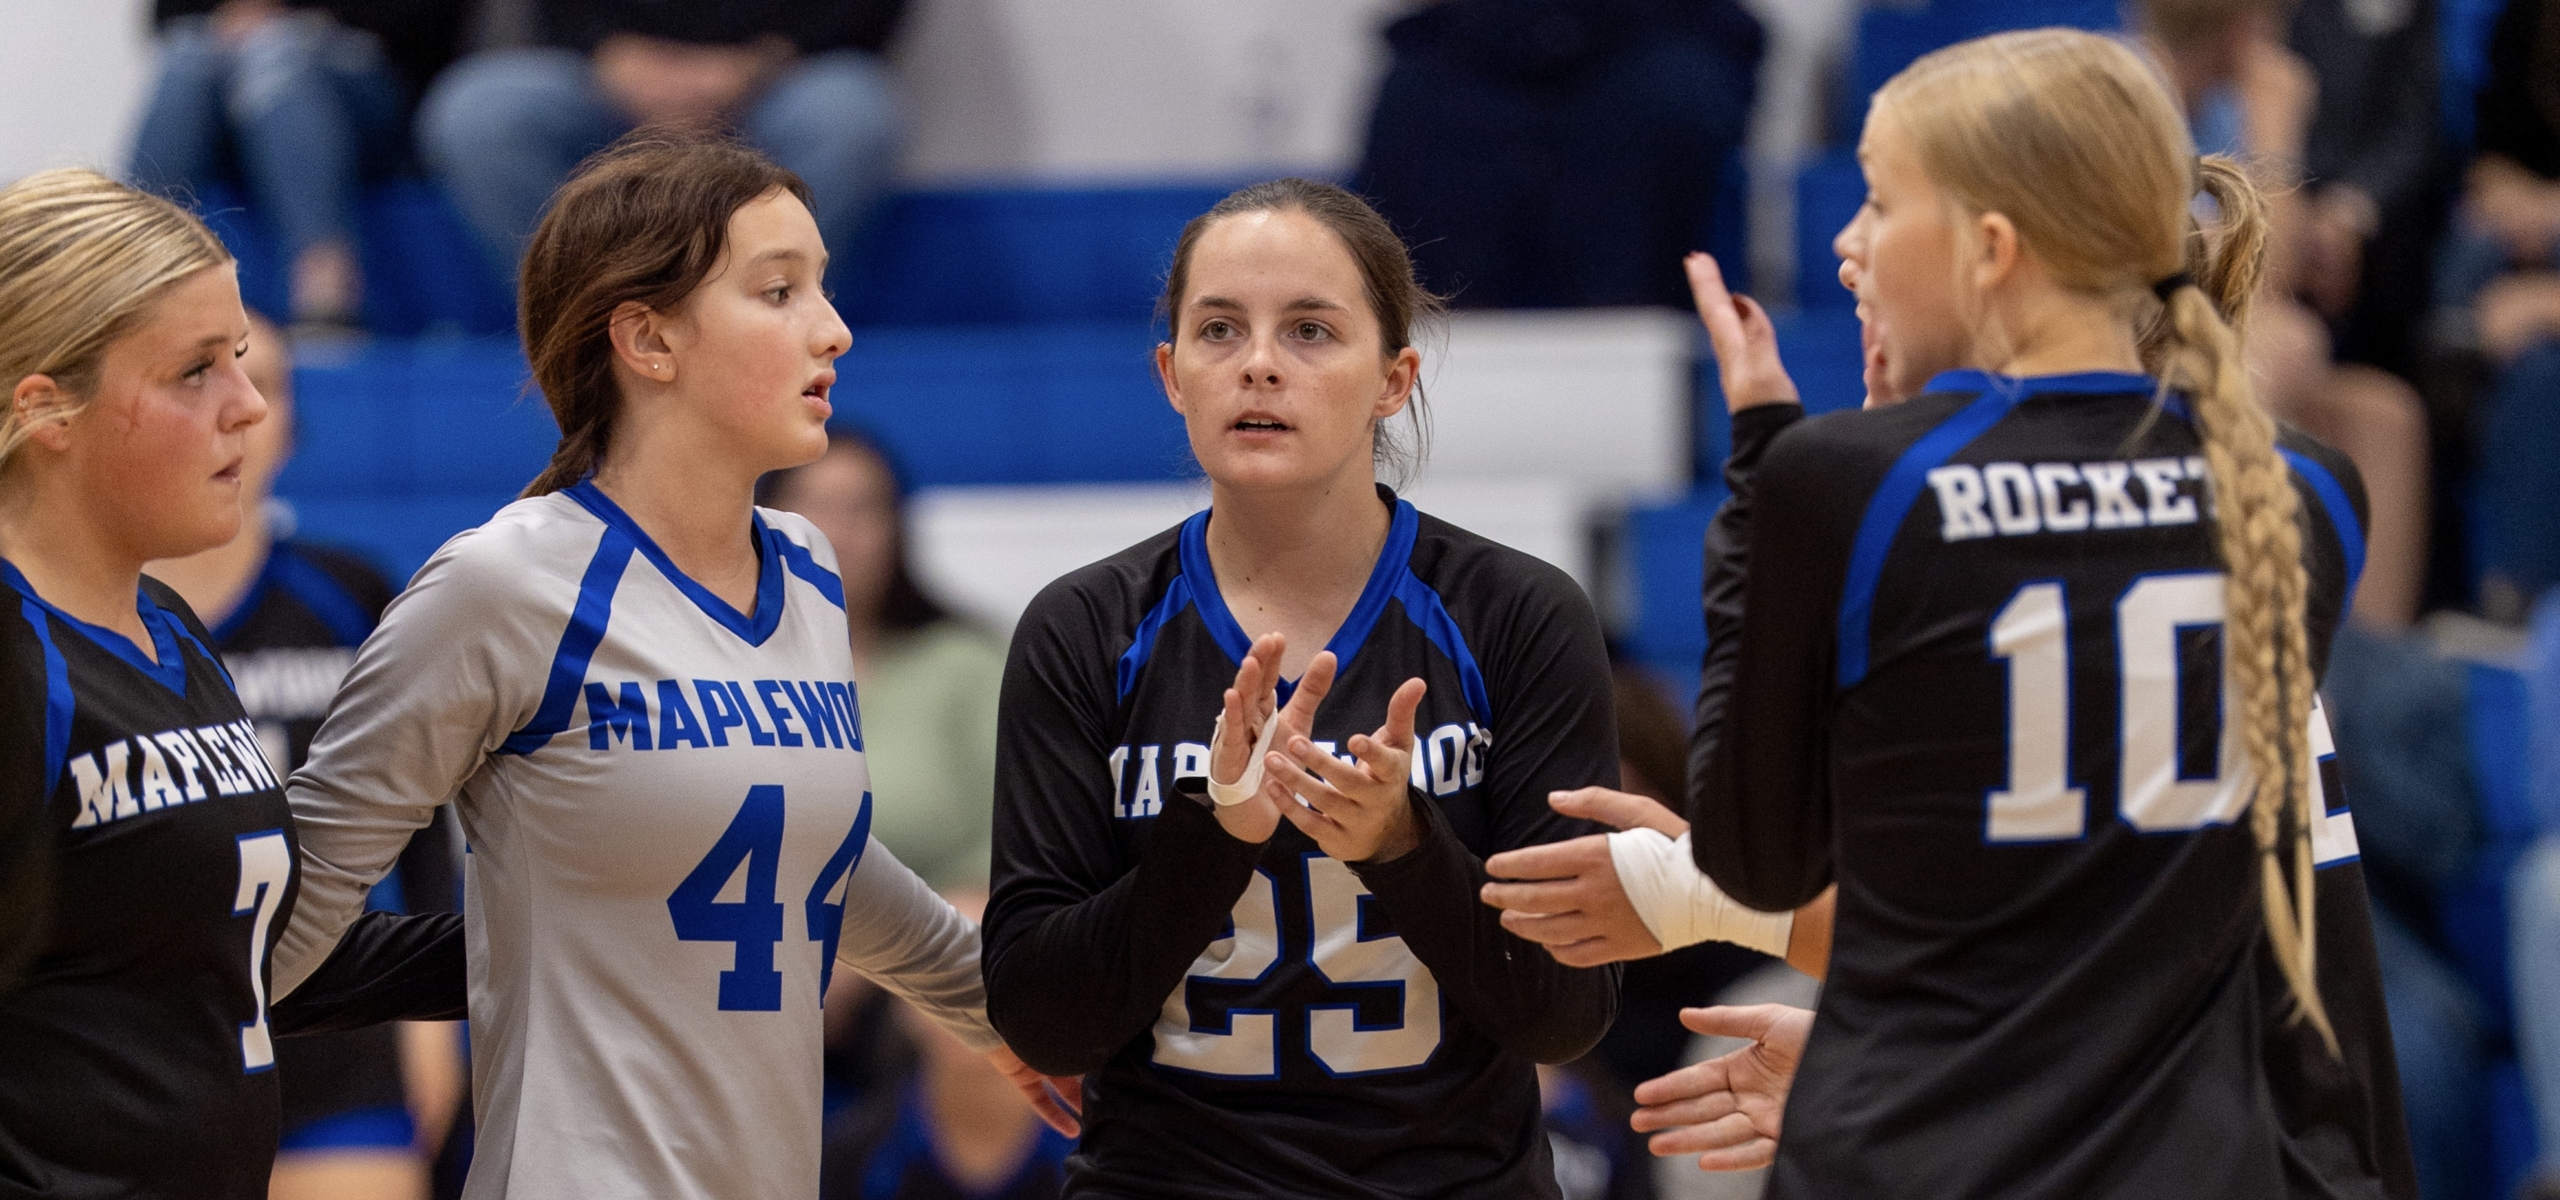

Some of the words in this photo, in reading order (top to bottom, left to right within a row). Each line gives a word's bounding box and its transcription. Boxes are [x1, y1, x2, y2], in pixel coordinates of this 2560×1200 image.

[1982, 569, 2256, 847] 10
[231, 828, 292, 1074] 7
[667, 784, 873, 1011] 44
[1150, 850, 1445, 1081] 25
